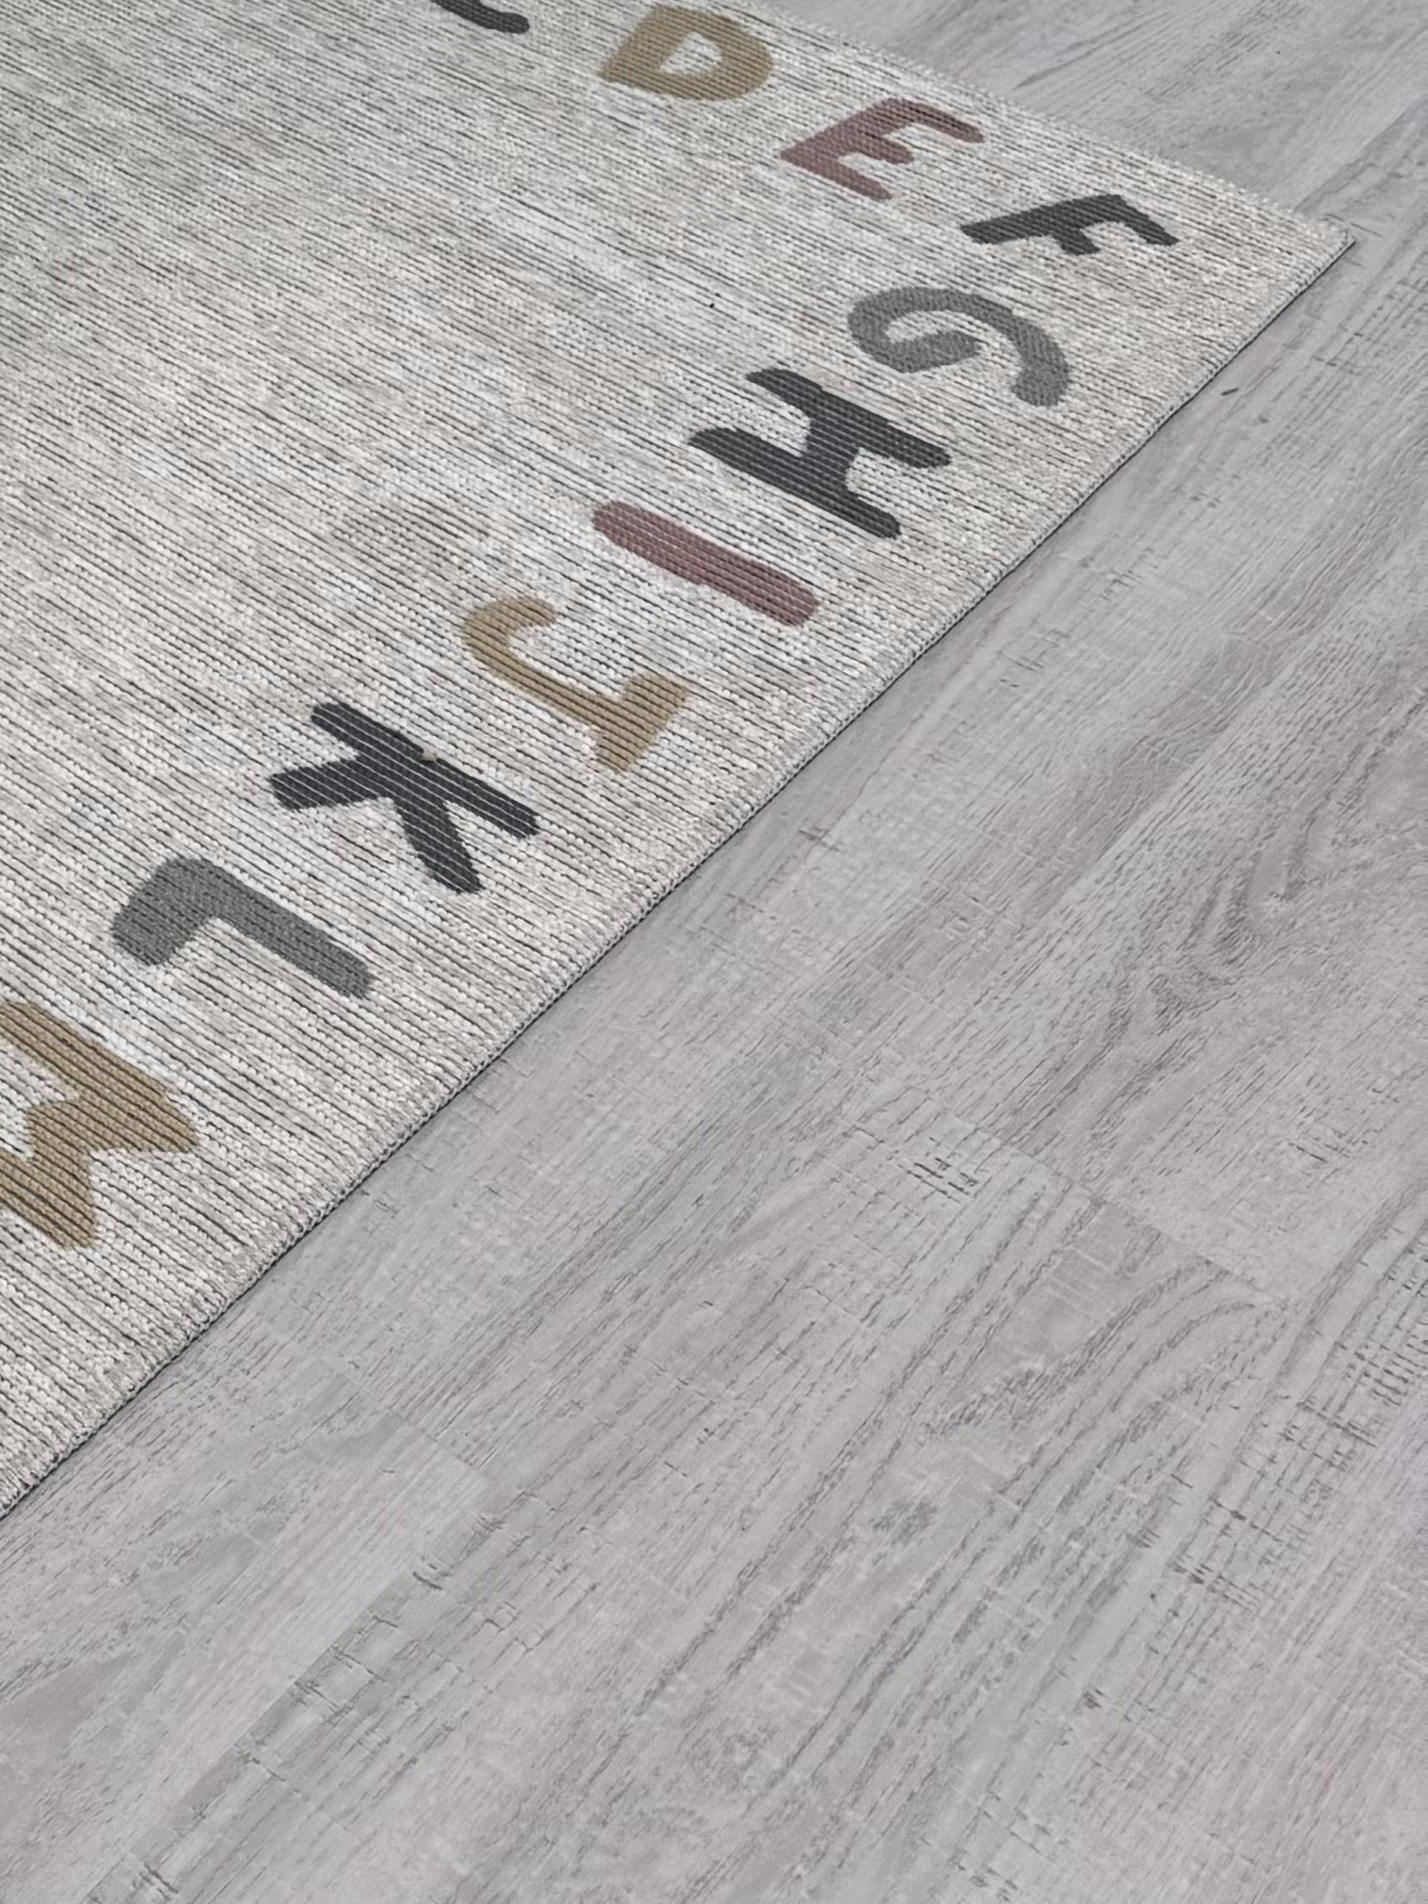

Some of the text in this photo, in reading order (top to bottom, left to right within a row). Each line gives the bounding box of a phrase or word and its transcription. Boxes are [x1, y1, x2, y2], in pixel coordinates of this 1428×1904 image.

[598, 3, 775, 101] D
[779, 97, 984, 201] E
[961, 193, 1180, 257] F
[847, 284, 1074, 406] G
[691, 367, 952, 540] H
[591, 501, 817, 627] I
[459, 595, 691, 775] J
[267, 699, 540, 894] K
[111, 855, 376, 998] L
